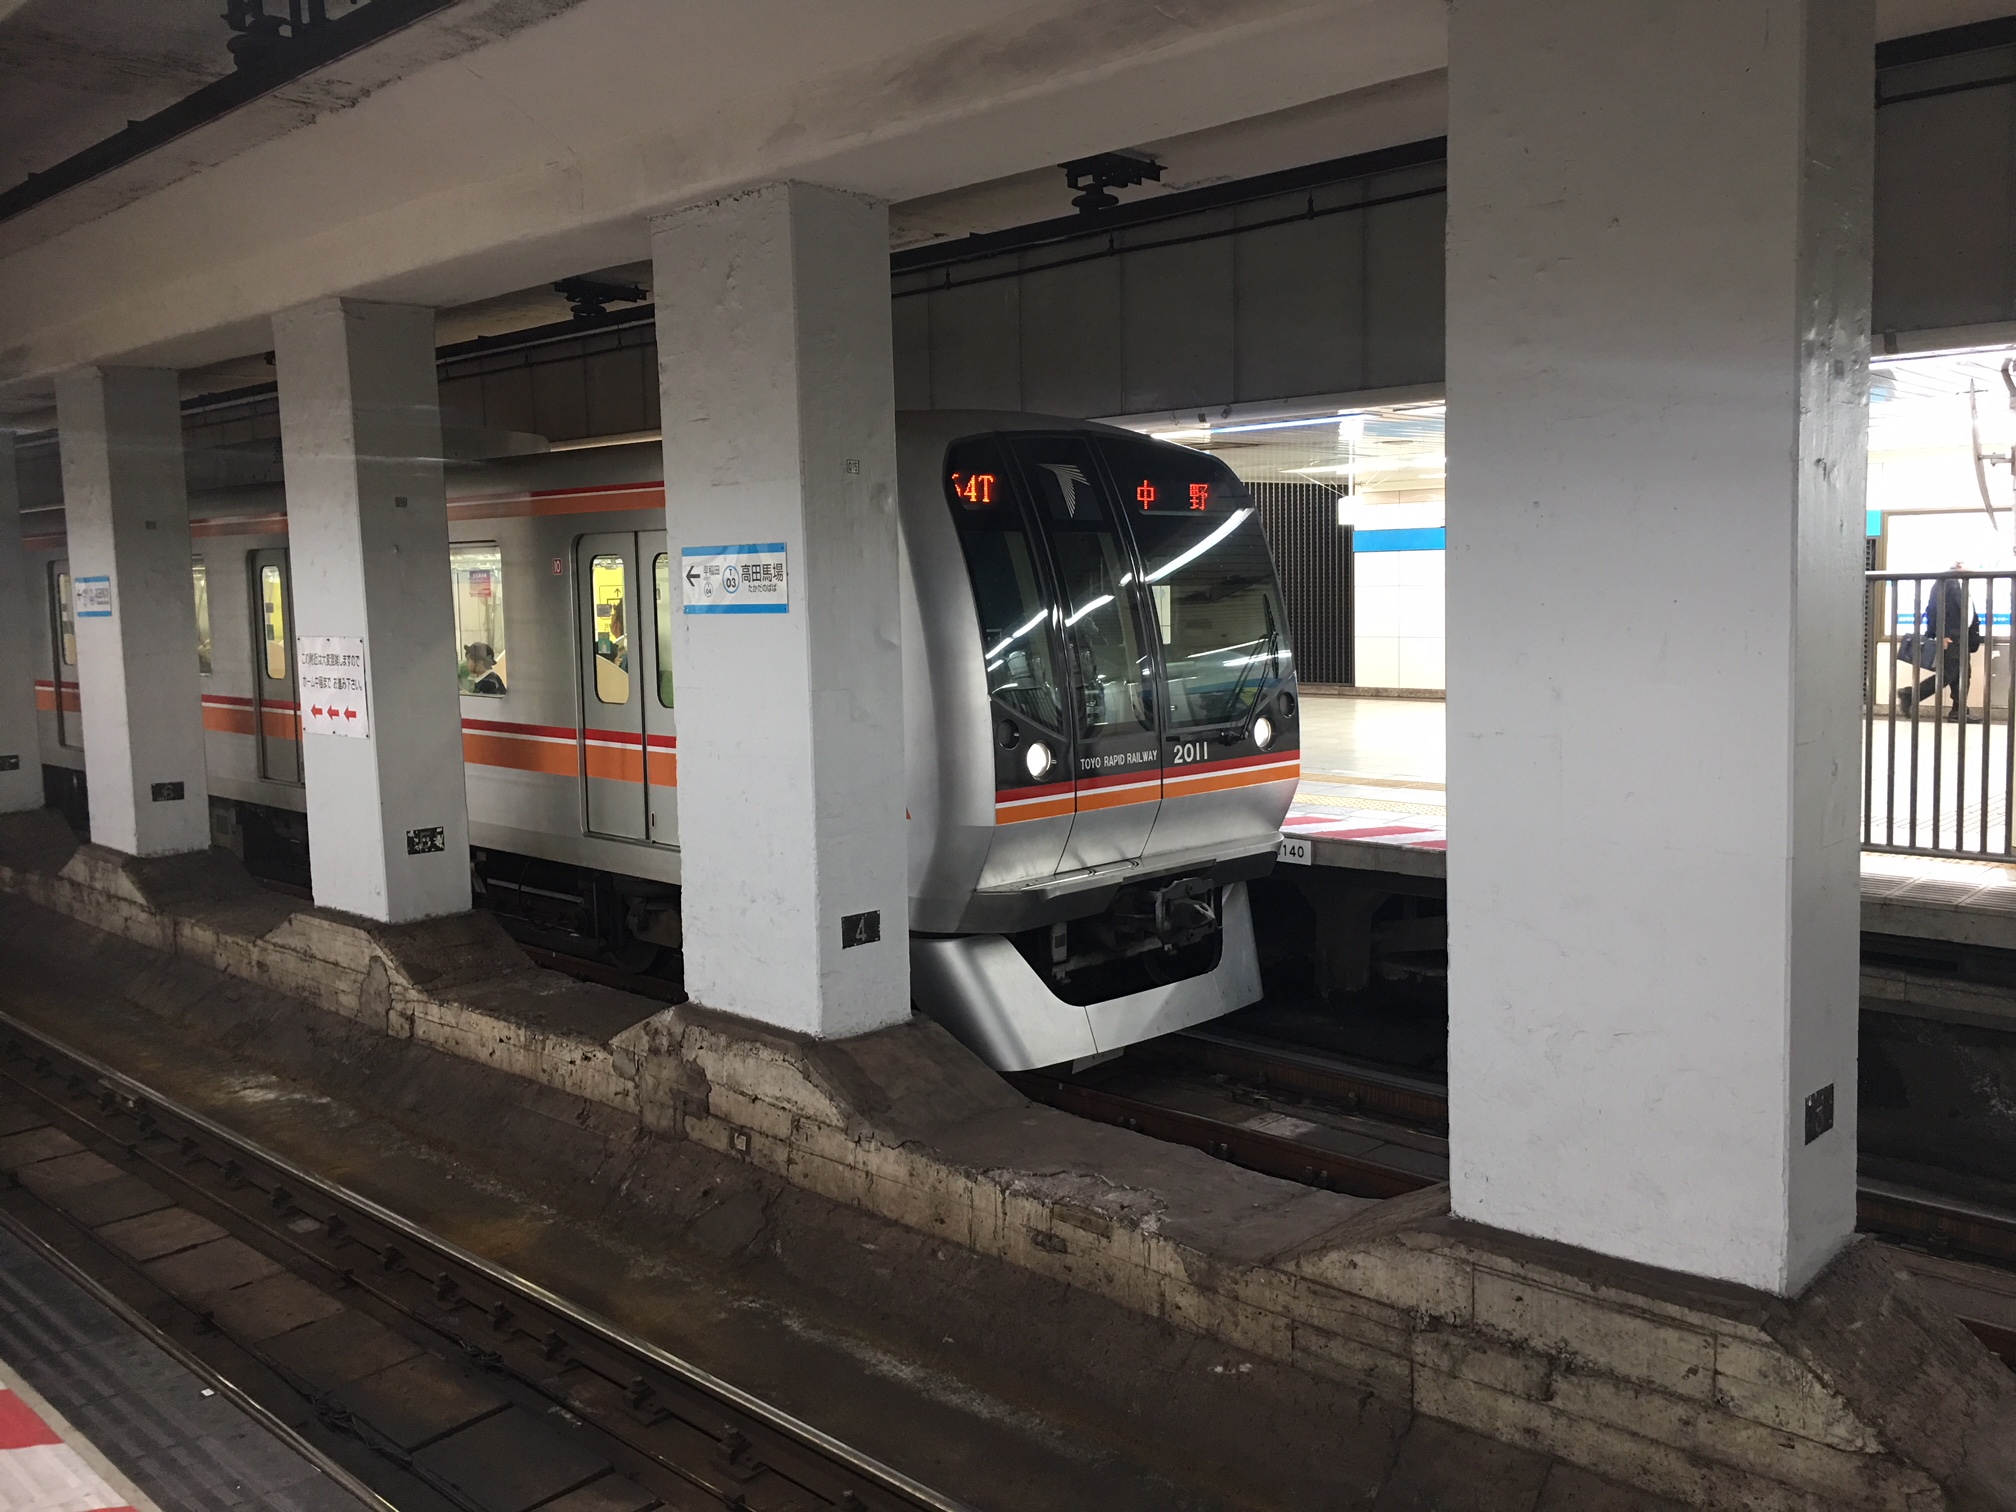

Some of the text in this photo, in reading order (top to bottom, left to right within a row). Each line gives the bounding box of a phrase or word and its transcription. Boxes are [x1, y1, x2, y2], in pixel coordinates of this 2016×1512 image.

[728, 568, 733, 576] T
[740, 562, 784, 583] 高田馬場
[726, 578, 737, 588] 03
[748, 583, 777, 593] たかだのばば
[1080, 749, 1158, 771] TOYO RAPID RAILWAY
[1173, 741, 1208, 764] 2011
[855, 915, 867, 941] 4
